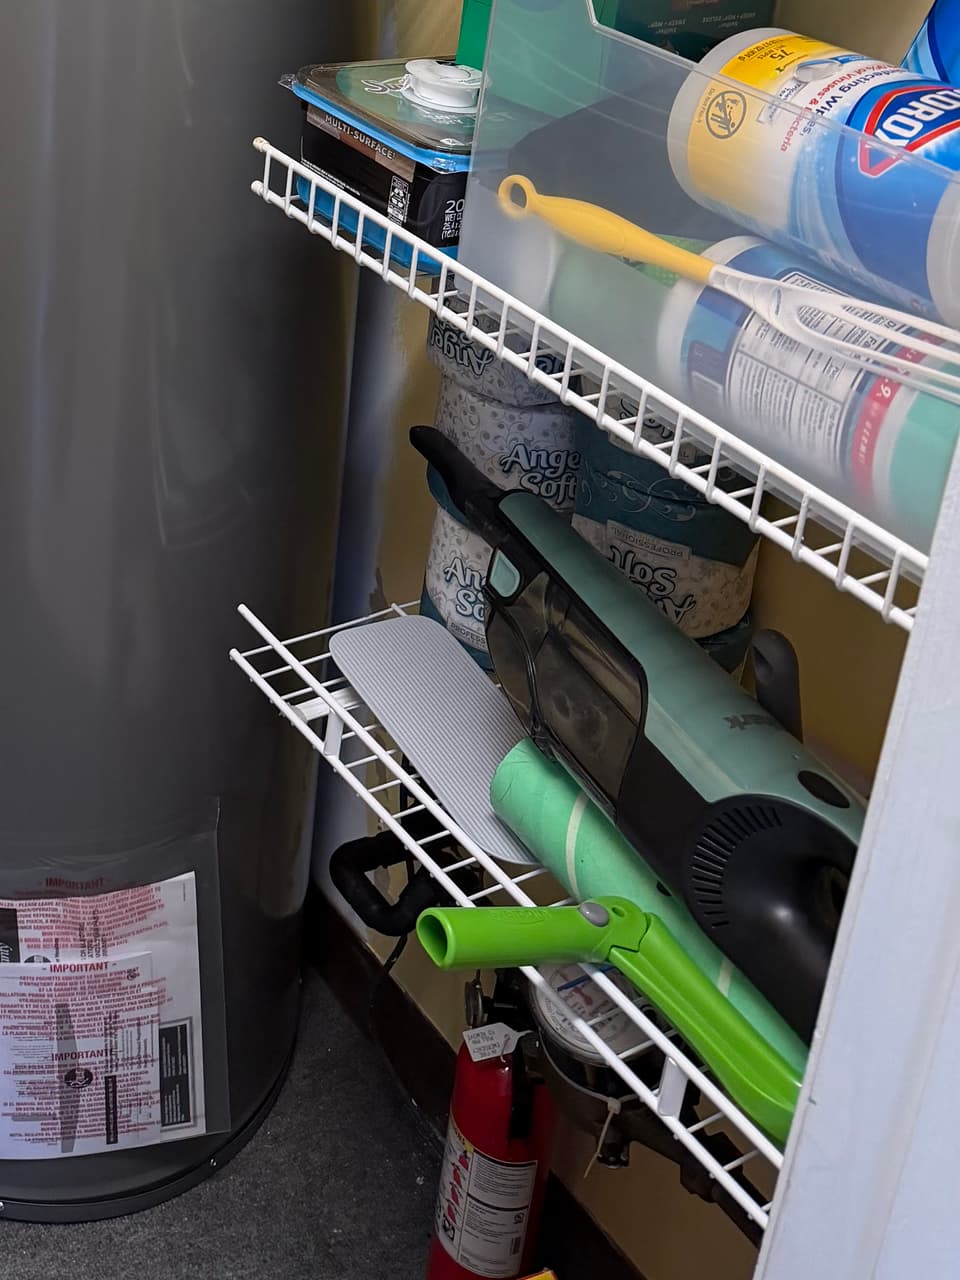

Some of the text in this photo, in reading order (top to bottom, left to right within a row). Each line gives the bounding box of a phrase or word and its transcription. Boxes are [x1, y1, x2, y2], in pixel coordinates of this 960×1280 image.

[769, 49, 794, 61] 75
[324, 113, 397, 161] MULTI-SURFACE!
[500, 443, 581, 478] Ange
[610, 527, 683, 558] PROFESSIONAL
[455, 588, 486, 622] So
[450, 622, 487, 644] PROFESS
[45, 877, 105, 890] IMPORTANT
[49, 961, 109, 973] IMPORTANT
